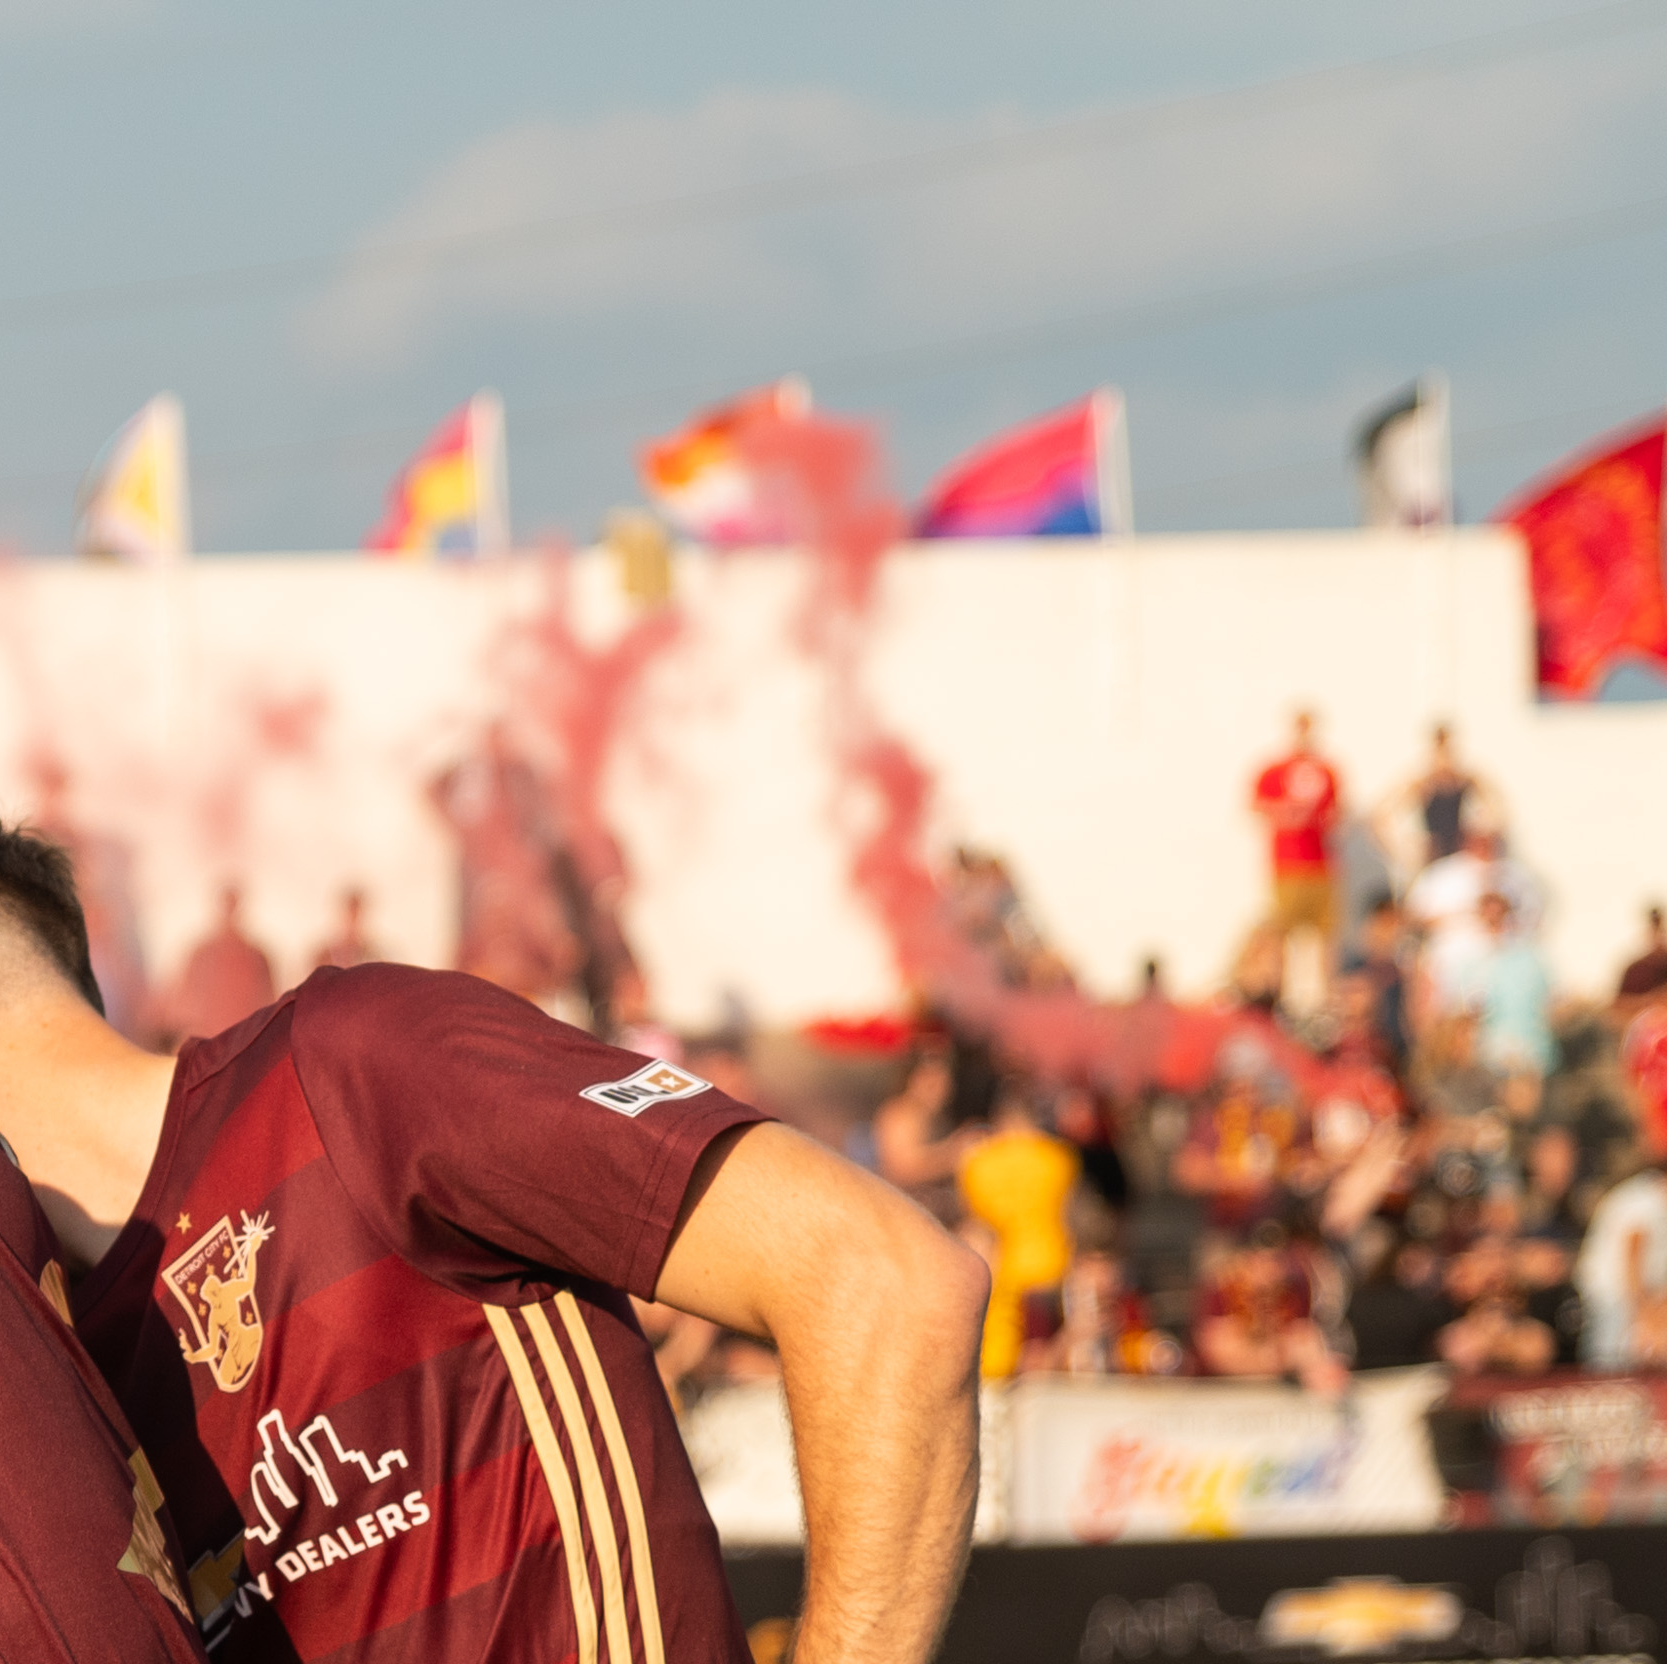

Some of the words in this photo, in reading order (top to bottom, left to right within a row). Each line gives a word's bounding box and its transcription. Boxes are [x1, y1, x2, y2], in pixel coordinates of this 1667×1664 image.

[174, 1251, 206, 1285] DETROIT
[205, 1242, 219, 1259] CITY
[275, 1490, 431, 1583] DEALERS
